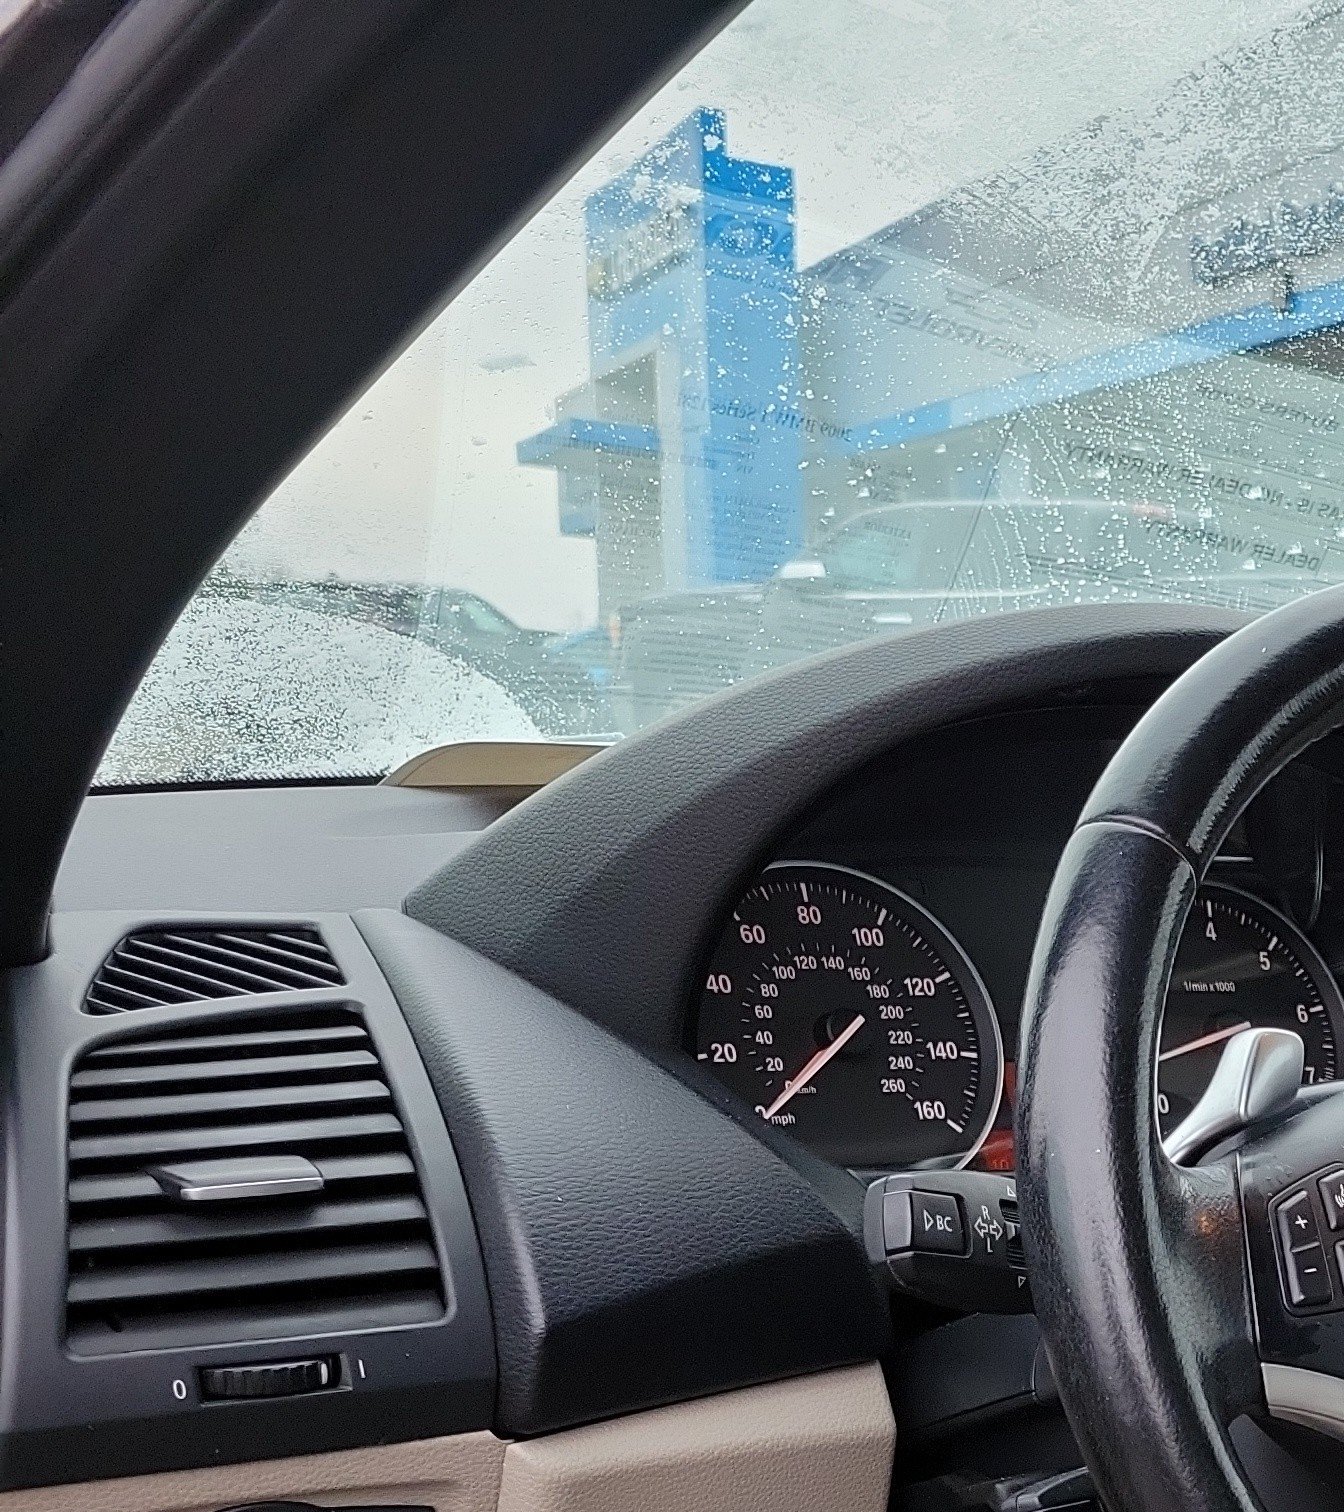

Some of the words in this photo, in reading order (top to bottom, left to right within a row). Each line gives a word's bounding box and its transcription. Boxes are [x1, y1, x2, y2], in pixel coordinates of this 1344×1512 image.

[797, 905, 822, 925] 80
[740, 924, 766, 945] 60
[852, 927, 884, 947] 100
[1205, 921, 1217, 941] 4
[794, 955, 817, 969] 120
[821, 956, 845, 970] 140
[1259, 951, 1271, 970] 5
[772, 966, 796, 980] 100
[848, 966, 871, 981] 160
[706, 974, 732, 994] 40
[761, 983, 778, 998] 80
[866, 985, 890, 999] 180
[903, 976, 936, 997] 120
[755, 1004, 773, 1019] 60
[879, 1006, 904, 1020] 200
[1297, 1005, 1309, 1023] 6
[755, 1031, 773, 1045] 40
[888, 1031, 913, 1045] 220
[711, 1043, 737, 1062] 20
[926, 1041, 958, 1060] 140
[766, 1058, 784, 1072] 20
[888, 1056, 913, 1070] 240
[1305, 1066, 1316, 1084] 7
[881, 1079, 906, 1093] 260
[913, 1101, 946, 1119] 160
[1159, 1093, 1170, 1114] 0
[771, 1113, 796, 1126] mph
[981, 1205, 991, 1222] R
[936, 1215, 953, 1233] BC
[986, 1237, 994, 1253] L
[172, 1379, 188, 1401] 0
